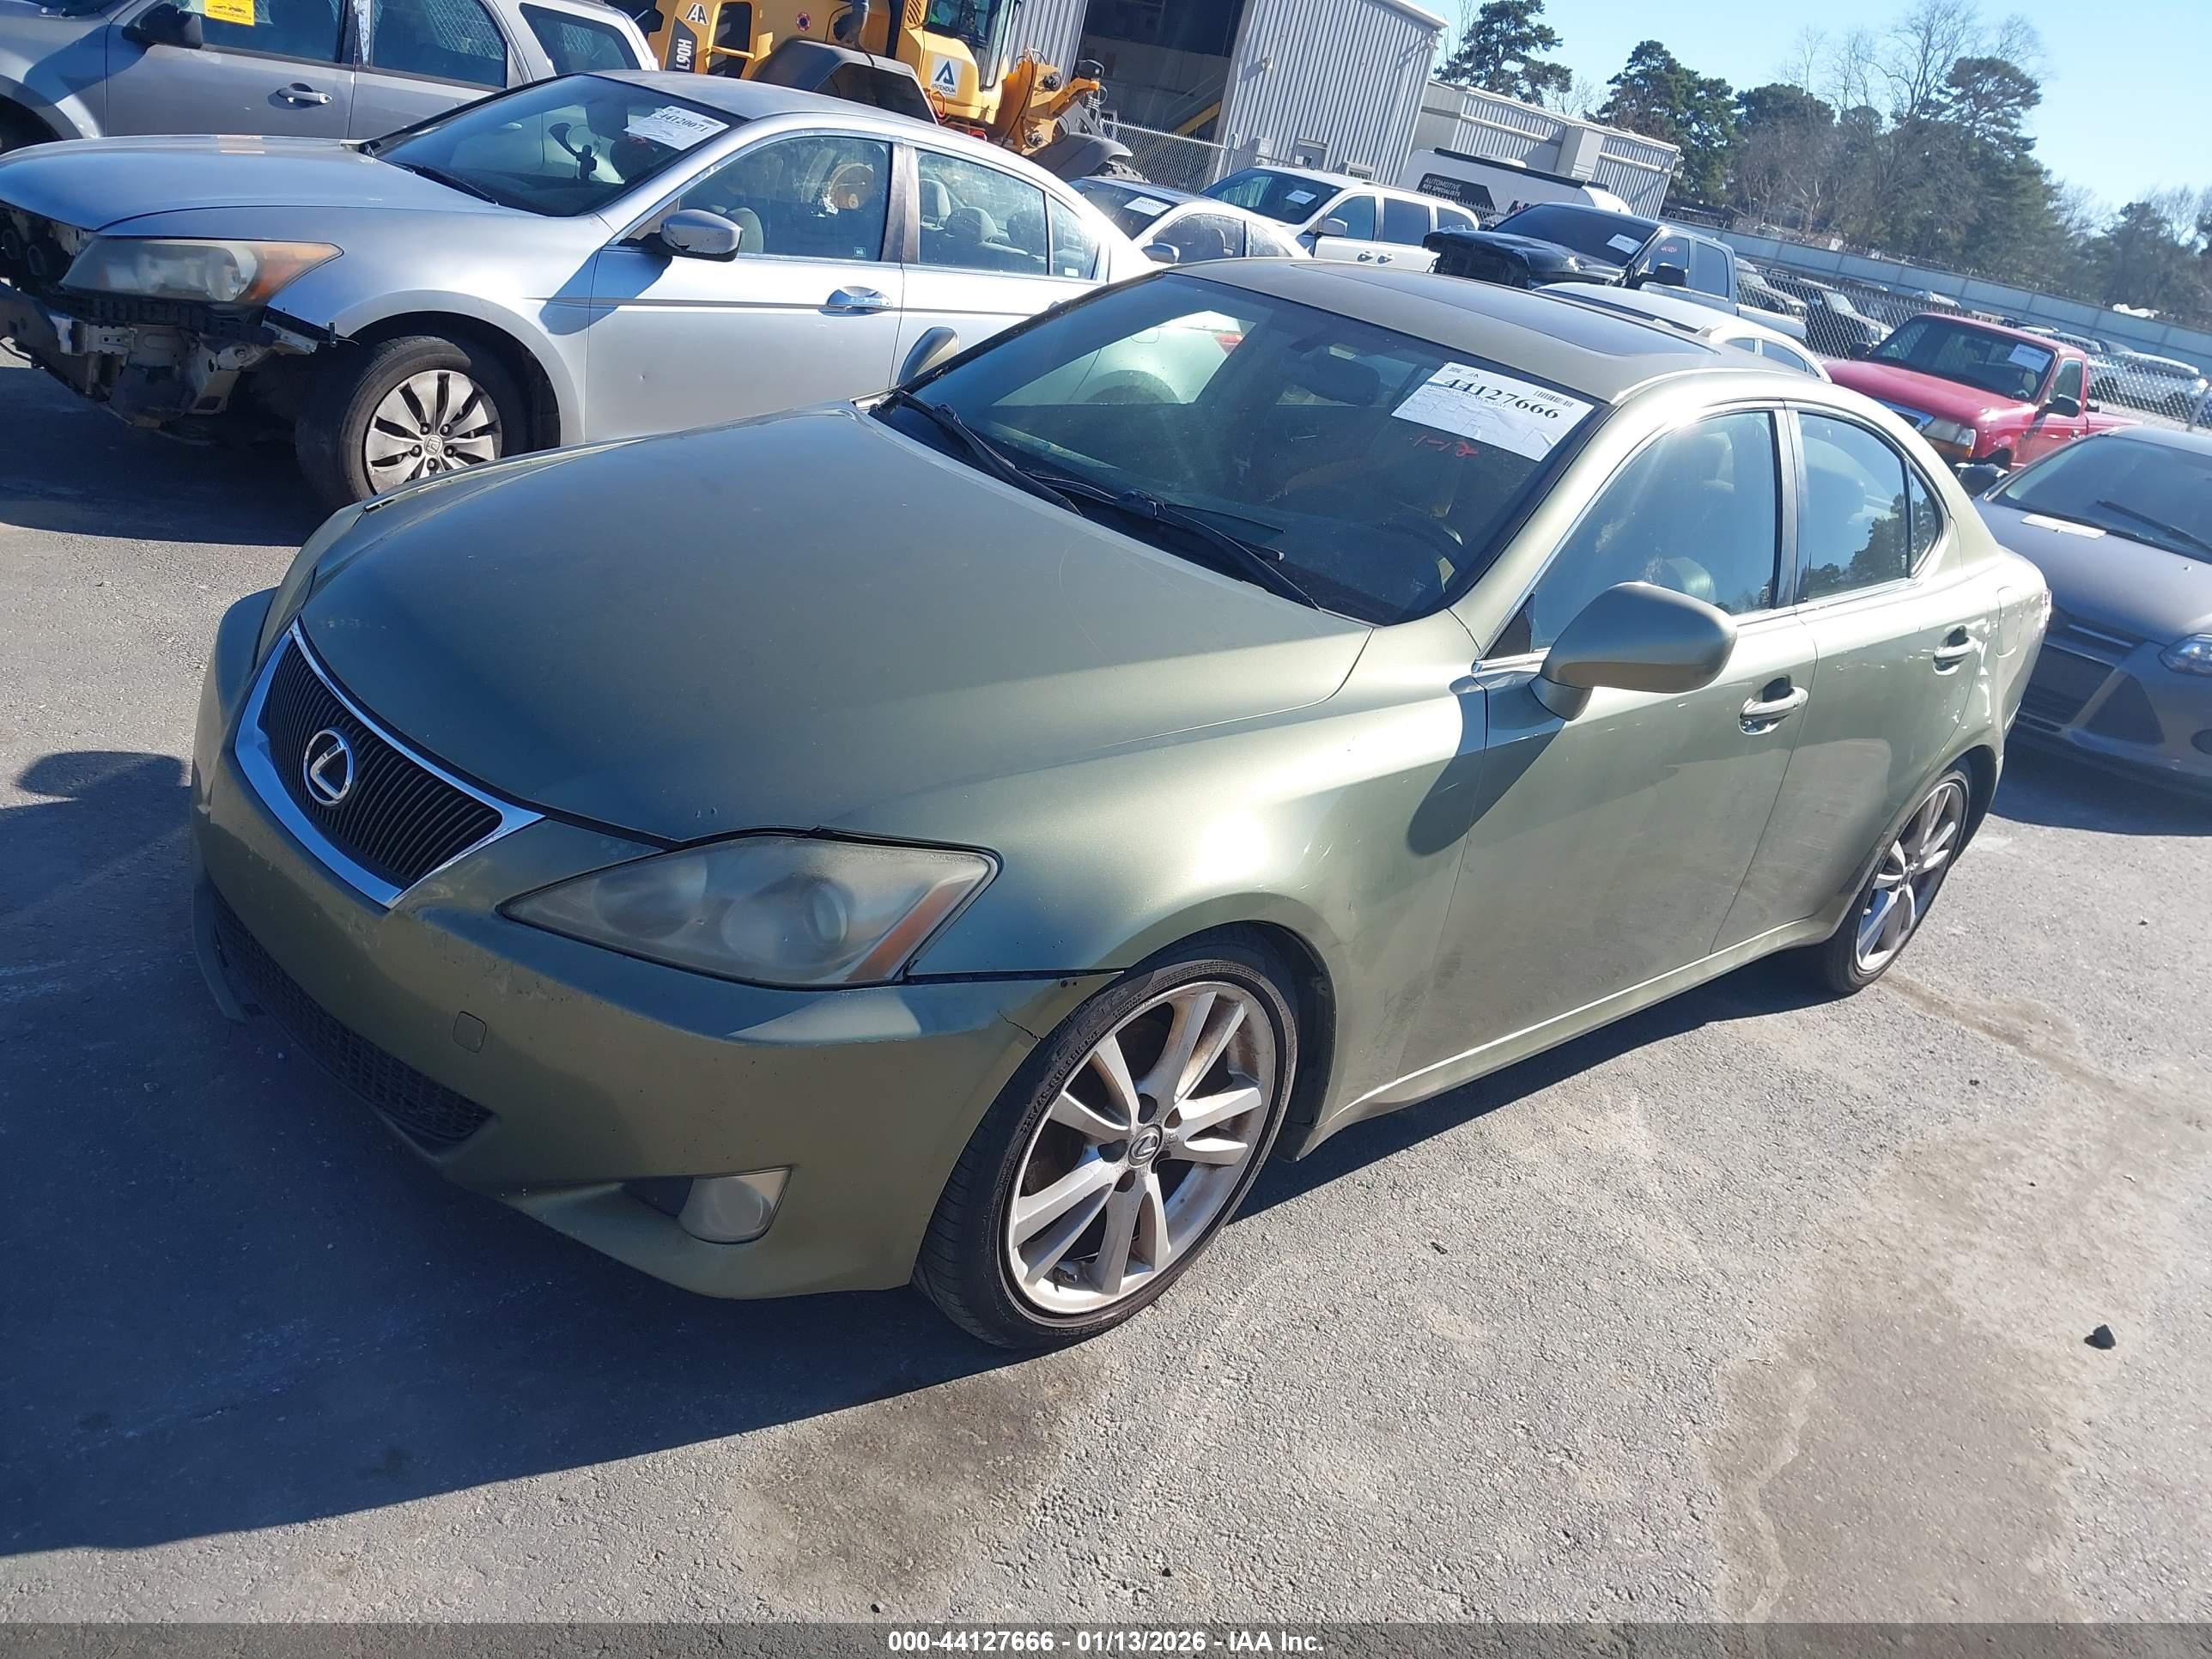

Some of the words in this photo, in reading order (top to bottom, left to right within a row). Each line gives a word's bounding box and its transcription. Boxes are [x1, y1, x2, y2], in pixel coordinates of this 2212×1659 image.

[676, 39, 692, 70] L90H
[1424, 177, 1462, 191] AUTOMOTIVE
[1431, 185, 1462, 198] SPECIALISTS
[1443, 378, 1561, 420] 44127666
